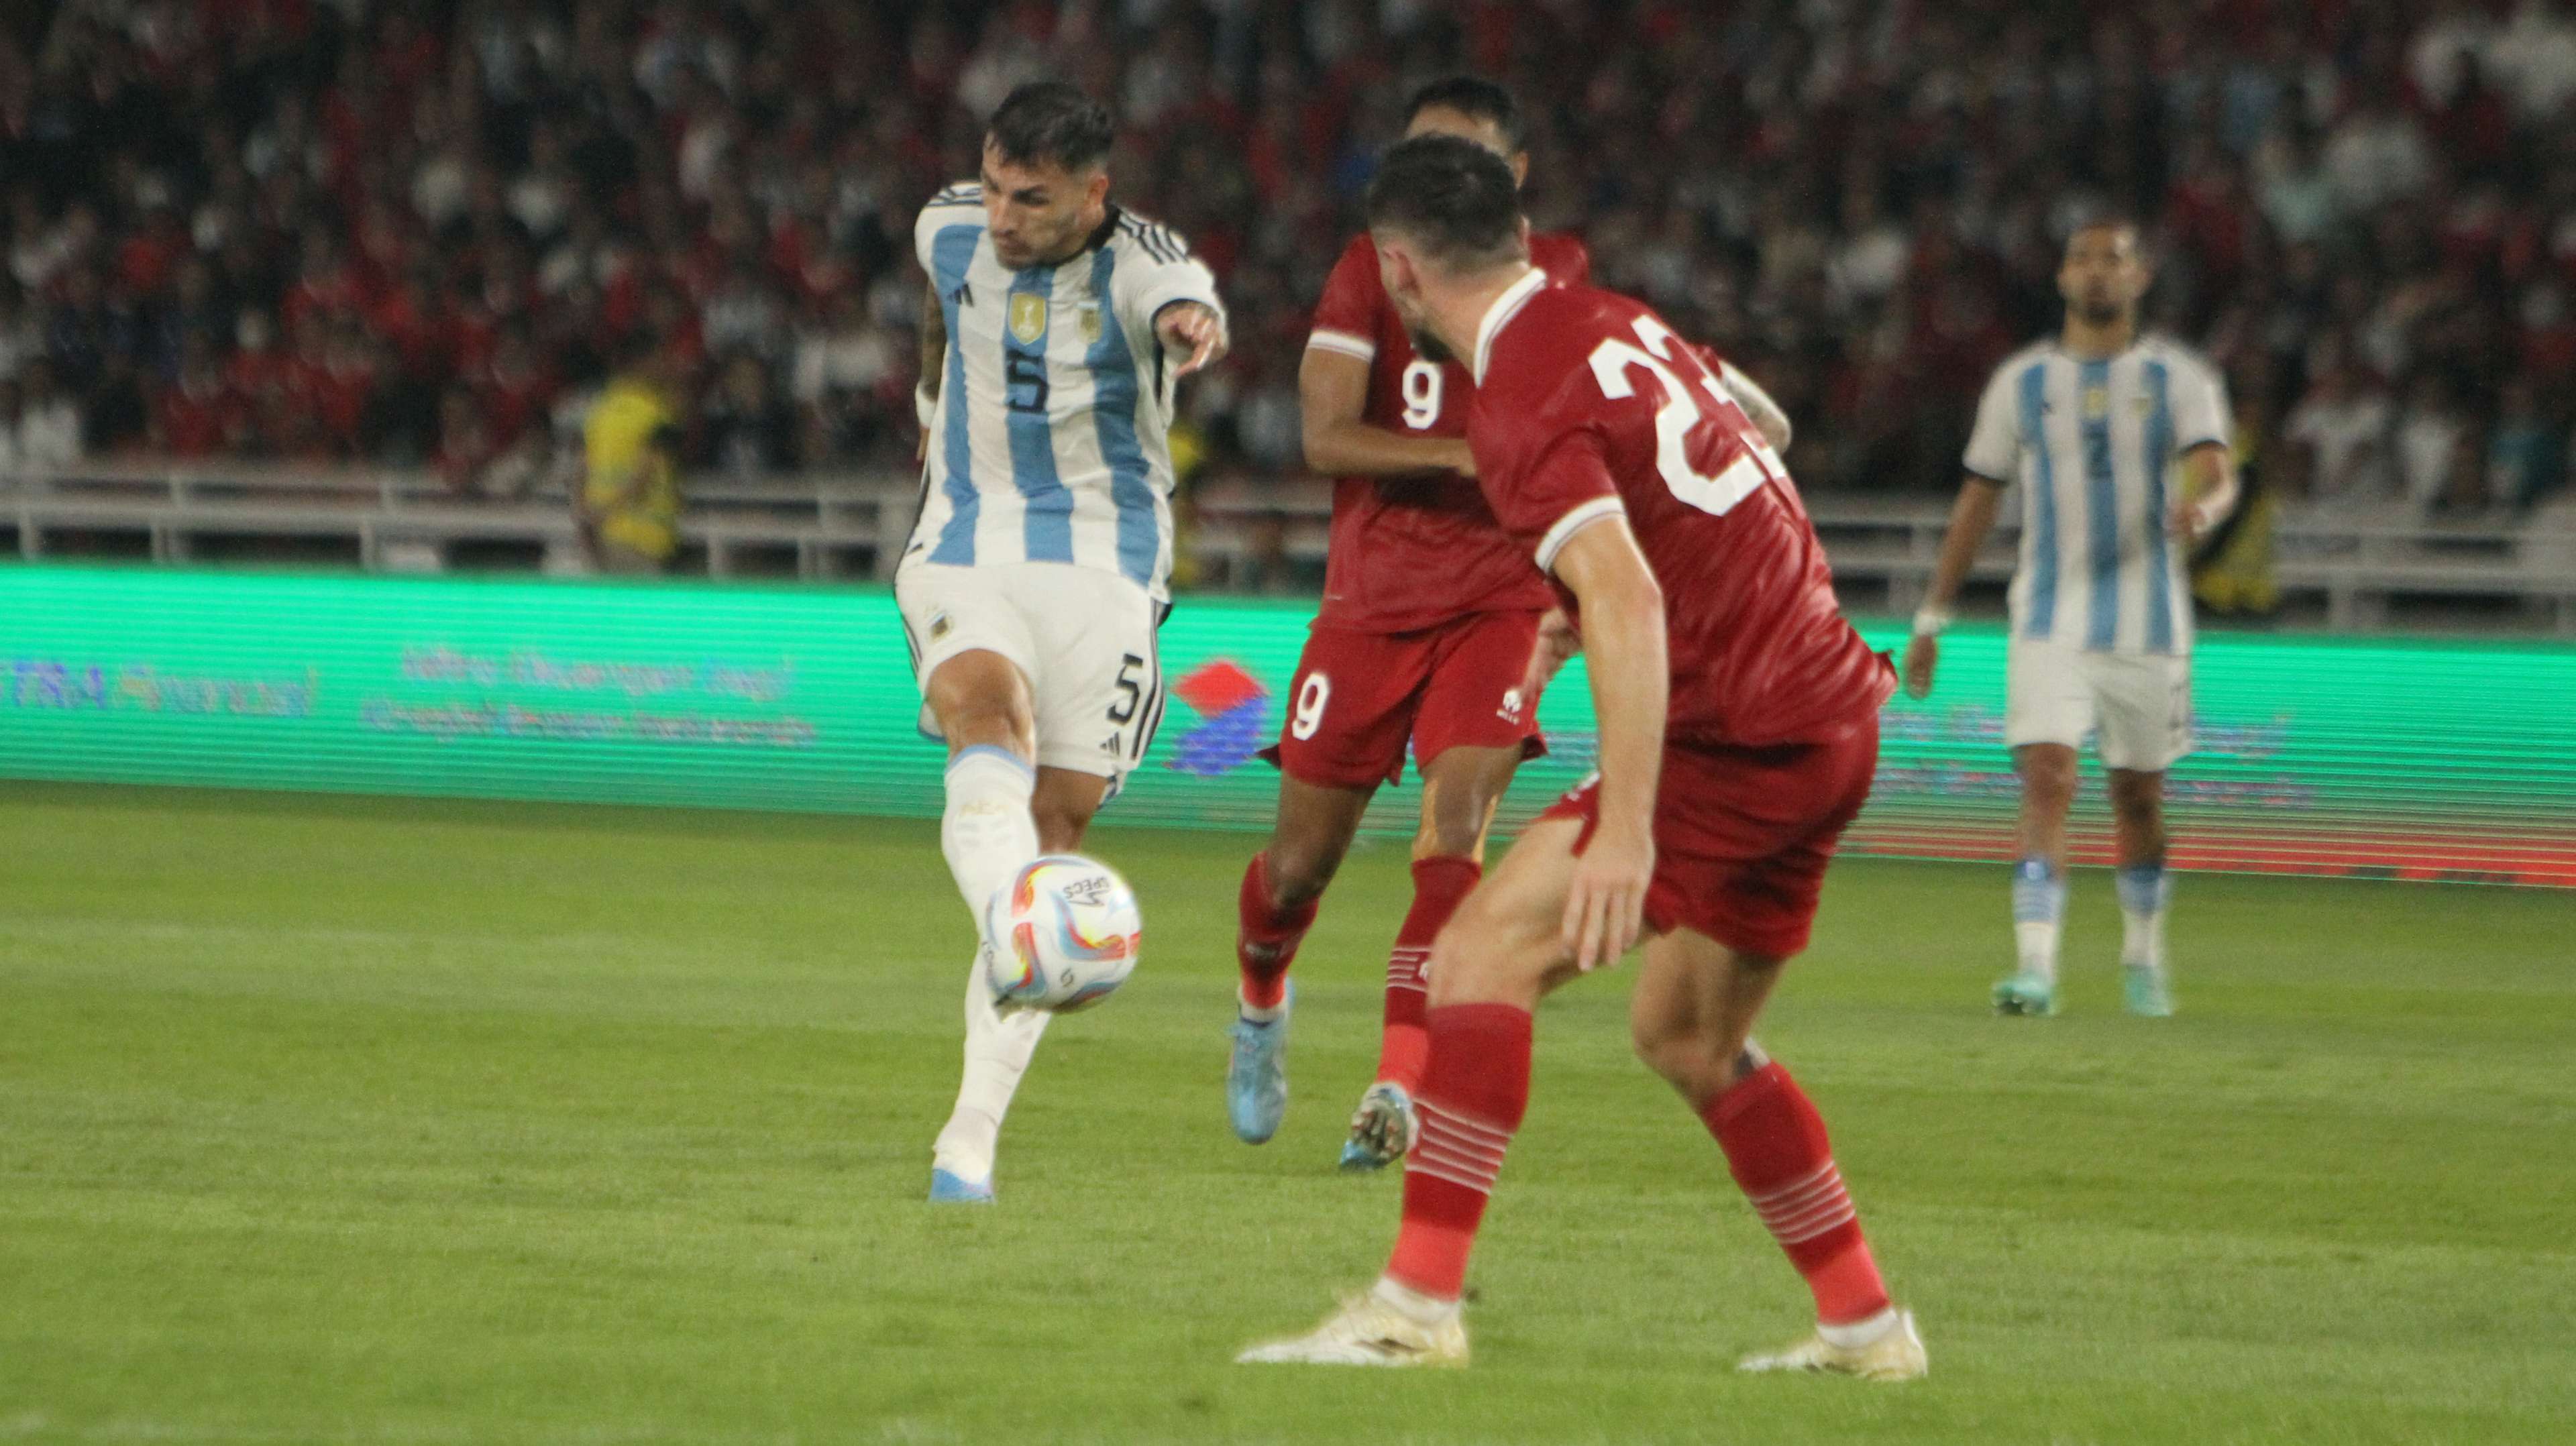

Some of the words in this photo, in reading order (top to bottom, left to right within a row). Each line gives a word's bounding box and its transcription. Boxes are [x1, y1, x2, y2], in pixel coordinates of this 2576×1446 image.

[1007, 349, 1049, 414] 5
[1402, 359, 1442, 429] 9
[1106, 653, 1144, 726] 5
[1291, 671, 1330, 741] 9
